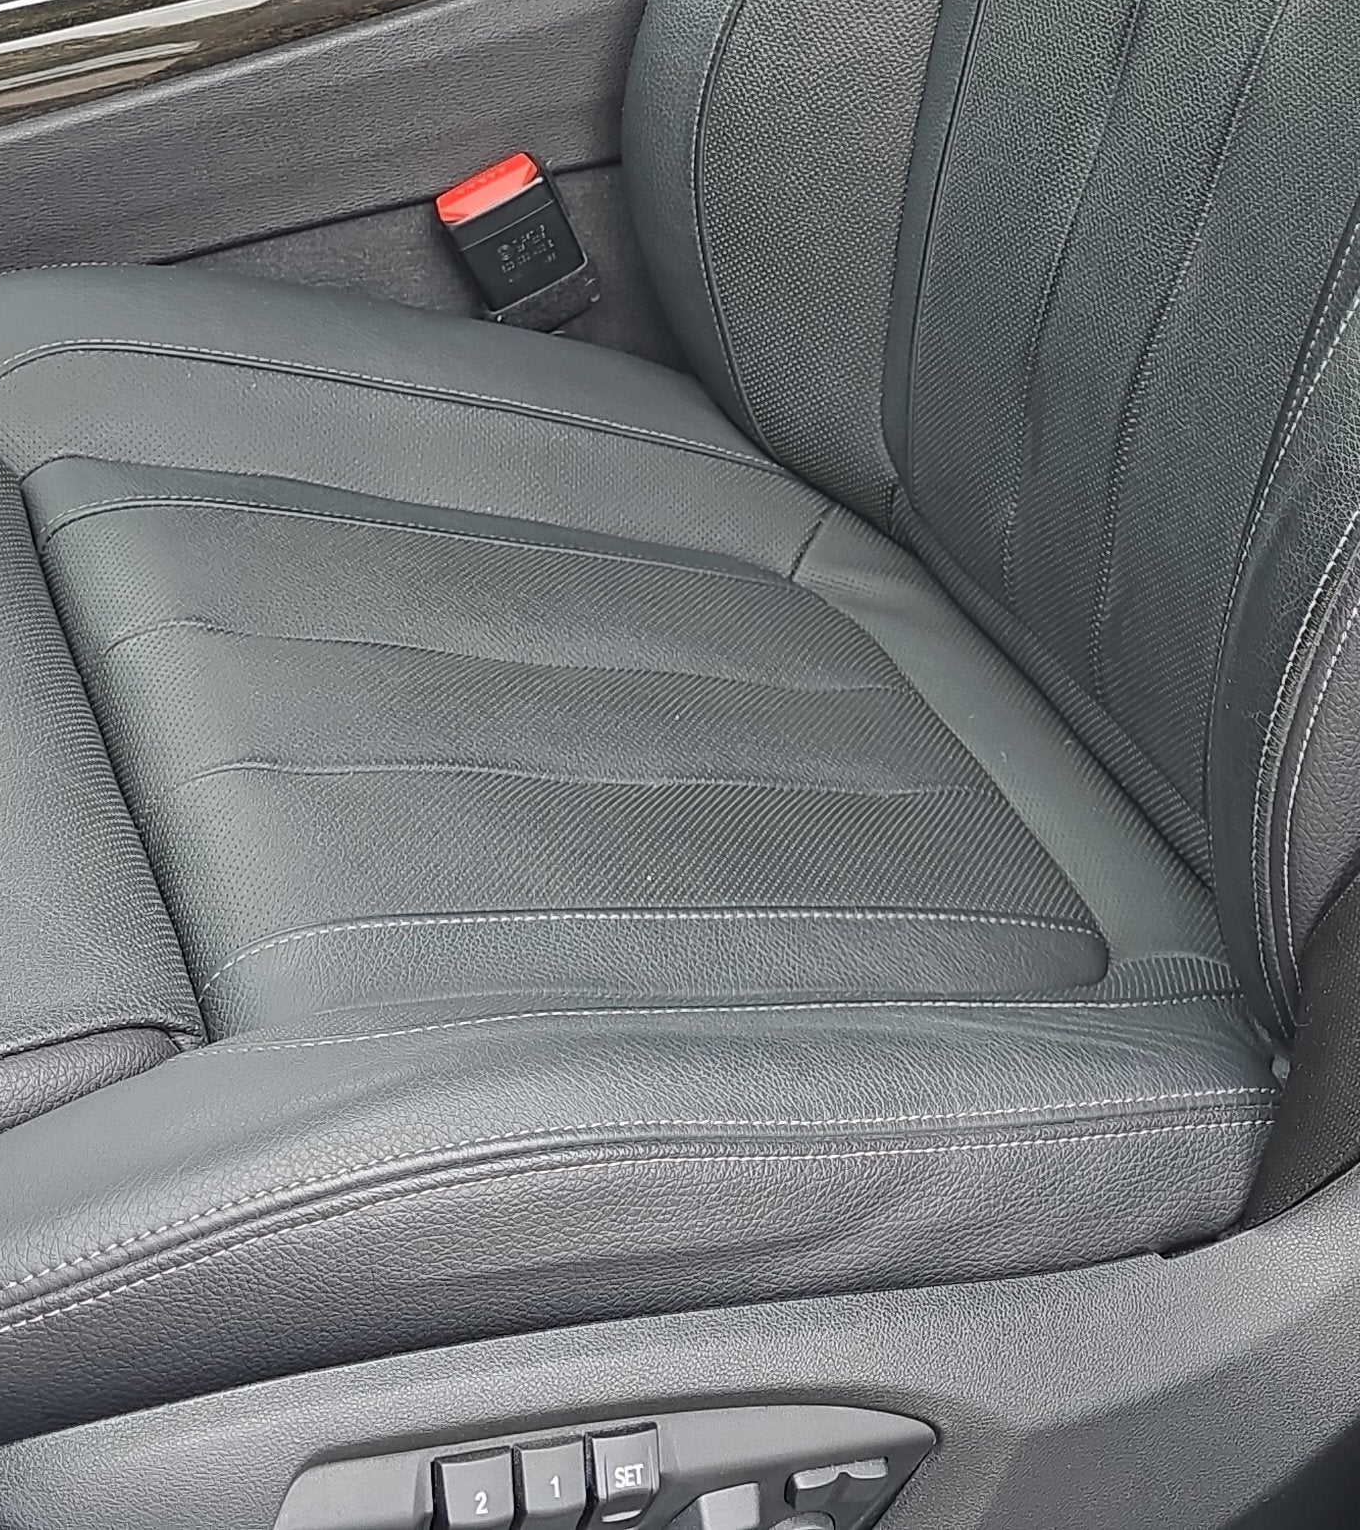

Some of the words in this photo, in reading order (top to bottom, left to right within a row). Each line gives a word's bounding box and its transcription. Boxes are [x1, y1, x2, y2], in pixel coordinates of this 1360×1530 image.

[550, 1475, 561, 1498] 1
[614, 1464, 644, 1489] SET
[474, 1491, 488, 1515] 2
